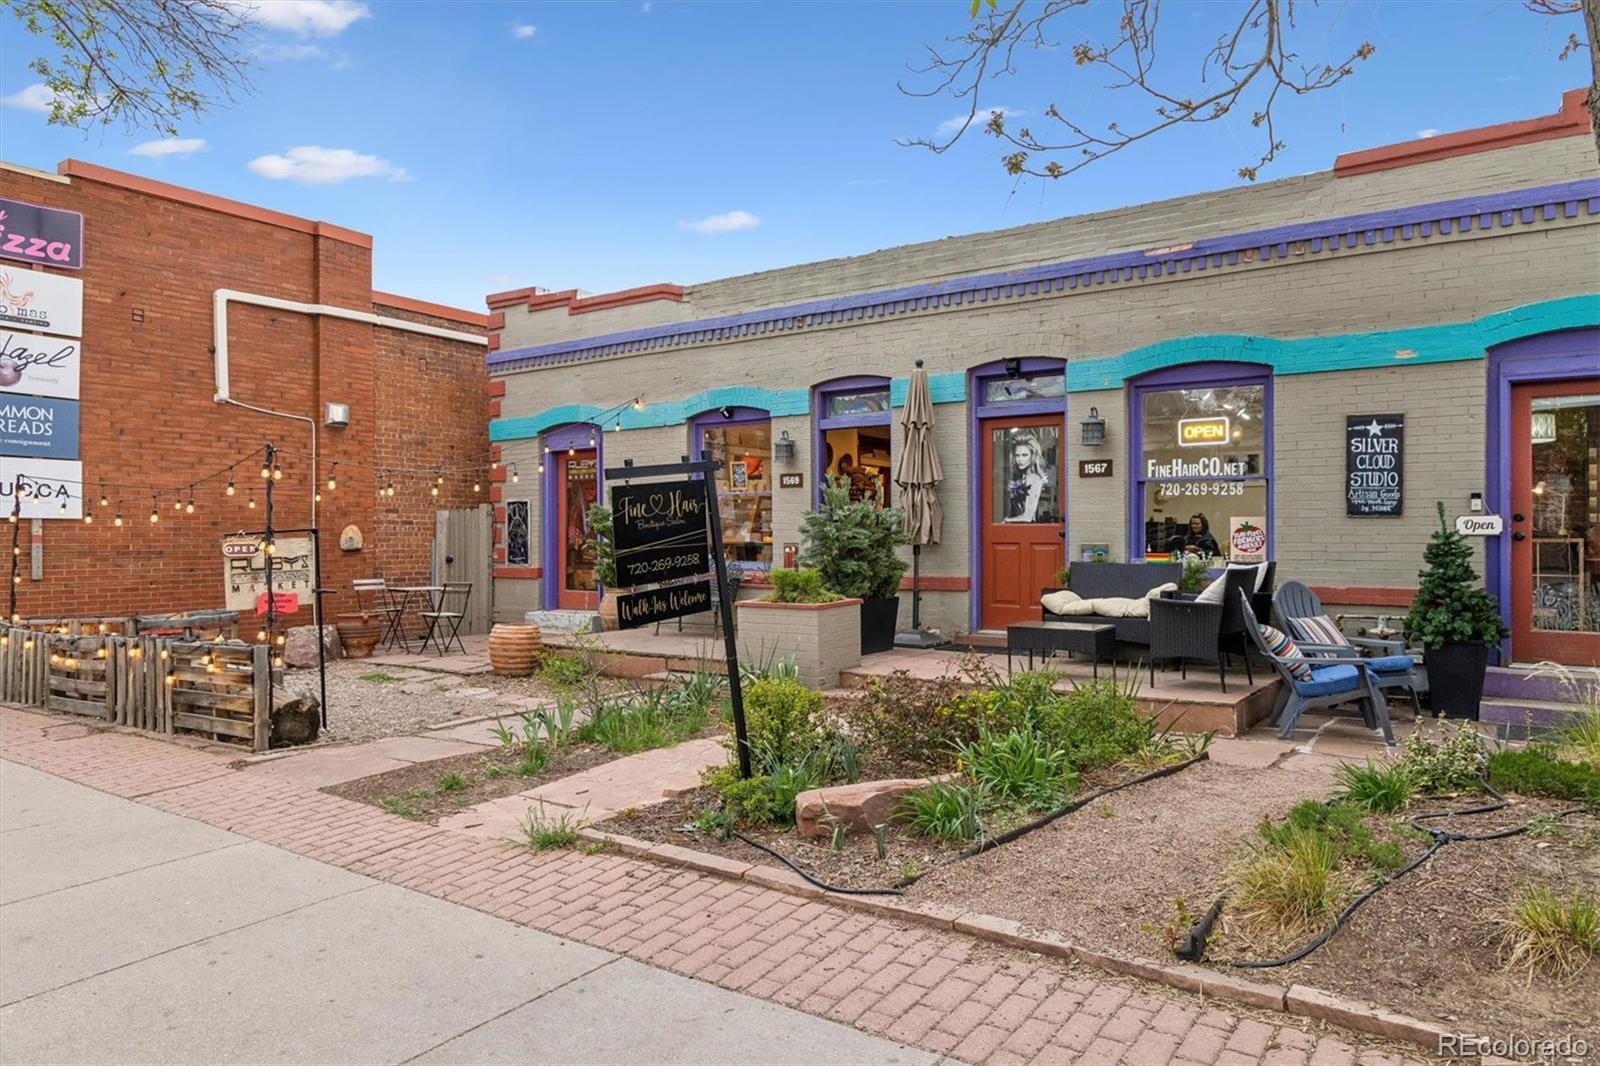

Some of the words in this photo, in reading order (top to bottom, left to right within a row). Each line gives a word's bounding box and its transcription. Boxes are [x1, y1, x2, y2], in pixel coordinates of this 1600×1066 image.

[17, 307, 47, 320] mas
[1184, 424, 1224, 439] OPEN
[1351, 438, 1399, 453] SILVER
[1084, 463, 1108, 474] 1567
[1356, 454, 1395, 469] CLOUD
[782, 475, 800, 485] 1569
[1350, 471, 1399, 486] STUDIO
[1159, 482, 1244, 497] 720-269-9258
[1380, 489, 1400, 498] Goods
[614, 495, 649, 525] Fine
[667, 489, 701, 517] Hair
[1463, 519, 1496, 532] Open
[627, 553, 700, 574] 720-269-9258
[232, 581, 309, 593] MAKET
[622, 595, 667, 620] Walk-Ins
[669, 590, 707, 611] Welcome
